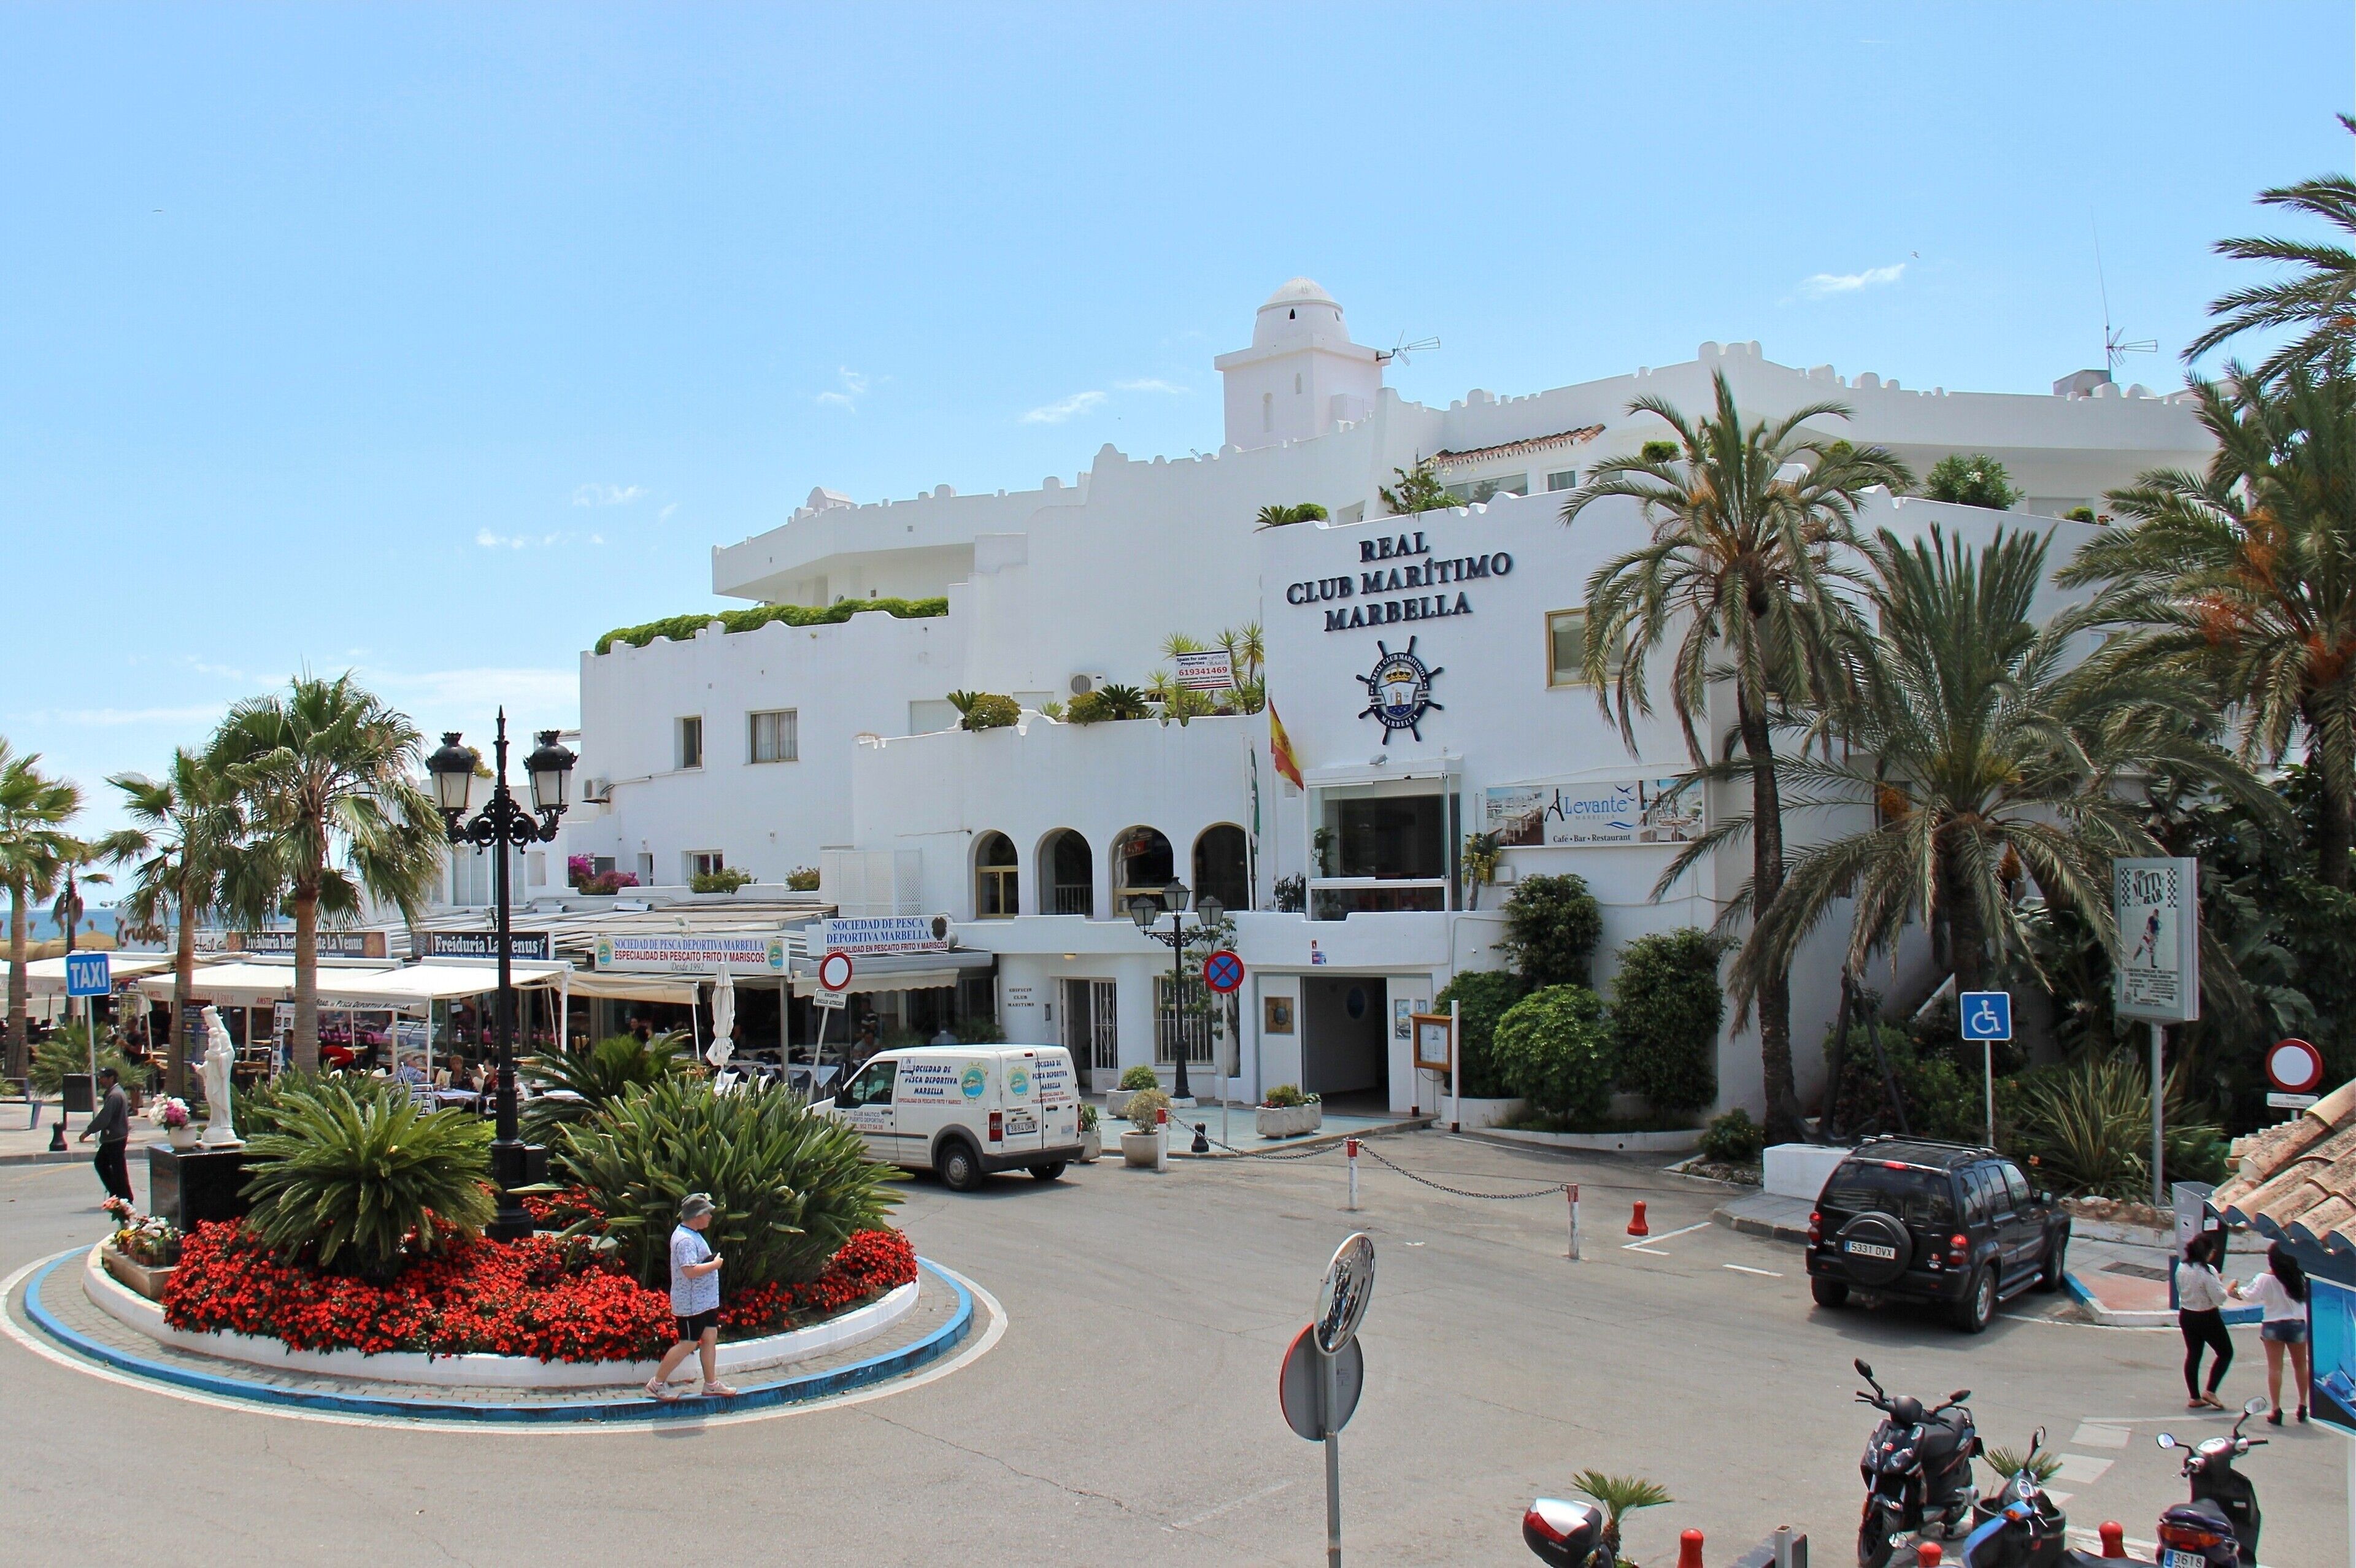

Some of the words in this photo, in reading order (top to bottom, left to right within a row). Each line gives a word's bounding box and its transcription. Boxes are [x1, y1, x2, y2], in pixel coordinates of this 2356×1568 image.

[1359, 532, 1430, 563] REAL
[1287, 576, 1354, 605] CLUB
[1361, 552, 1514, 594] MARÍTIMO
[1324, 591, 1473, 632] MARBELLA
[1179, 666, 1228, 675] 619341469
[1373, 665, 1383, 681] REAL
[1383, 655, 1398, 665] CLUB
[1381, 715, 1418, 727] MARBELLA
[1553, 834, 1569, 843] Café
[2144, 888, 2163, 904] BAR
[832, 920, 880, 931] SOCIEDAD
[882, 919, 894, 929] DE
[896, 918, 924, 928] PESCA
[327, 934, 337, 949] La
[337, 934, 363, 950] Venus
[434, 935, 485, 953] Freiduría
[510, 936, 538, 953] enus
[826, 933, 879, 944] DEPORTIVA
[880, 930, 930, 942] MARBELLA
[615, 939, 647, 950] SOCIEDAD
[650, 939, 658, 950] DE
[660, 940, 682, 950] PESCA
[683, 940, 723, 951] DEPORTIVA
[725, 940, 764, 951] MARBELLA
[826, 945, 864, 954] ESPECIALIDAD
[615, 950, 658, 960] ESPECIALIDAD
[660, 951, 668, 961] EN
[670, 951, 701, 961] PESCAITO
[703, 952, 722, 962] FRITO
[723, 953, 728, 962] Y
[730, 952, 765, 963] MARISCOS
[70, 961, 107, 989] TAXI
[671, 963, 688, 971] Desde
[690, 963, 704, 972] 1992
[1852, 1242, 1872, 1254] 5331
[1875, 1245, 1892, 1258] DVX
[2174, 1553, 2203, 1568] 3618
